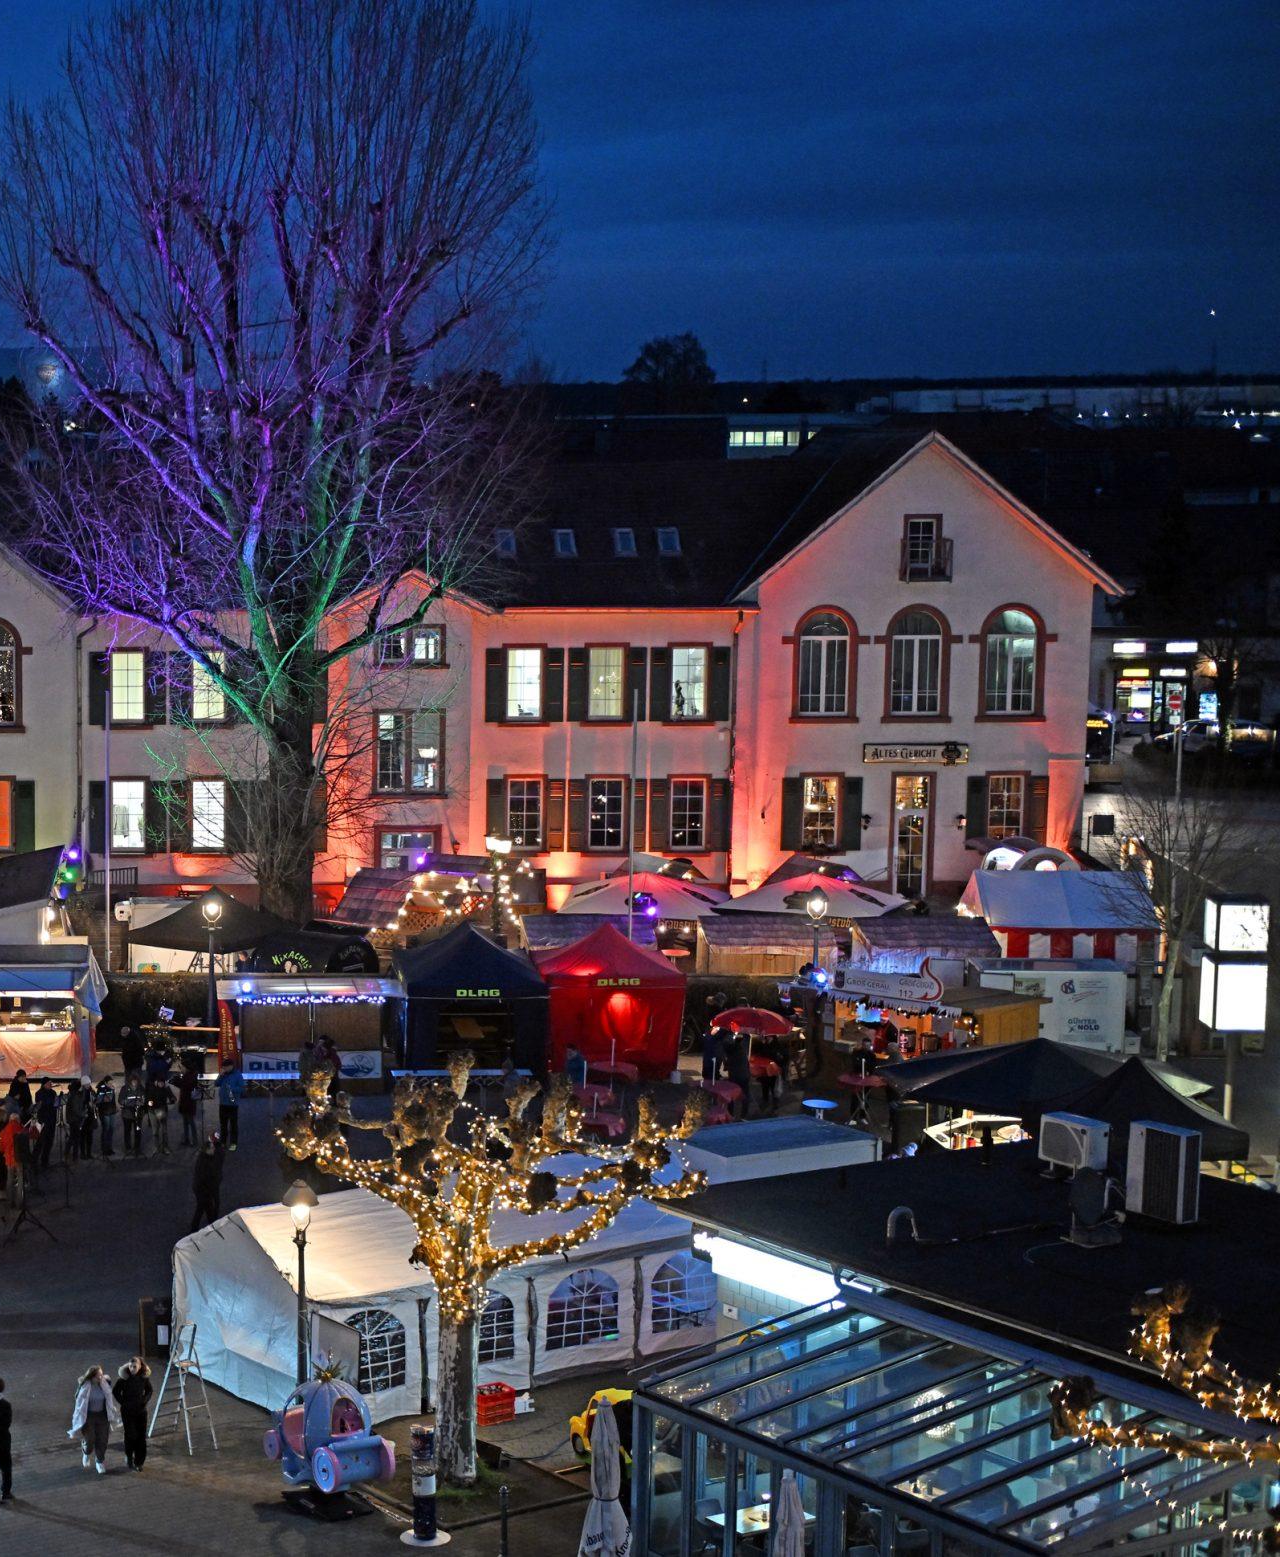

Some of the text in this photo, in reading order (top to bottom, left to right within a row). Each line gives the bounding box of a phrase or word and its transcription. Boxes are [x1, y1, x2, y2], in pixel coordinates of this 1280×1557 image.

[871, 748, 937, 760] ALTES GERICHT
[597, 977, 641, 987] DLRG
[456, 988, 501, 997] DLRG
